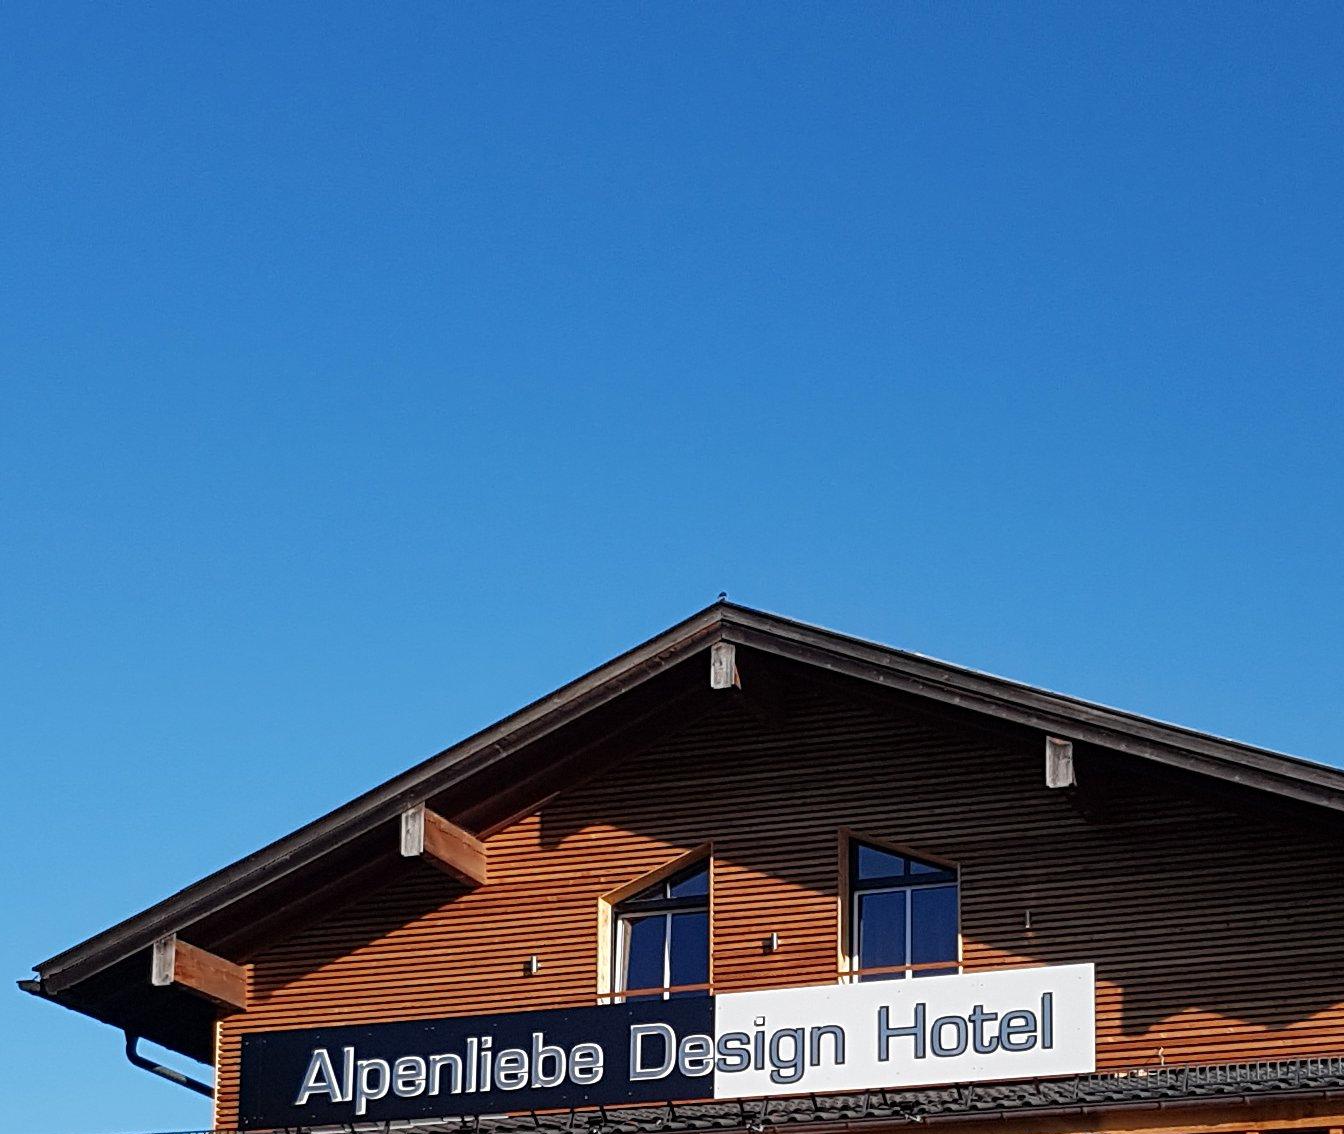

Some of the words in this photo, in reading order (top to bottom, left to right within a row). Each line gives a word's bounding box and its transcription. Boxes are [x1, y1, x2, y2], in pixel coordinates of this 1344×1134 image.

[294, 1033, 604, 1115] Alpenliebe
[629, 1016, 846, 1084] Design
[877, 992, 1053, 1062] Hotel
